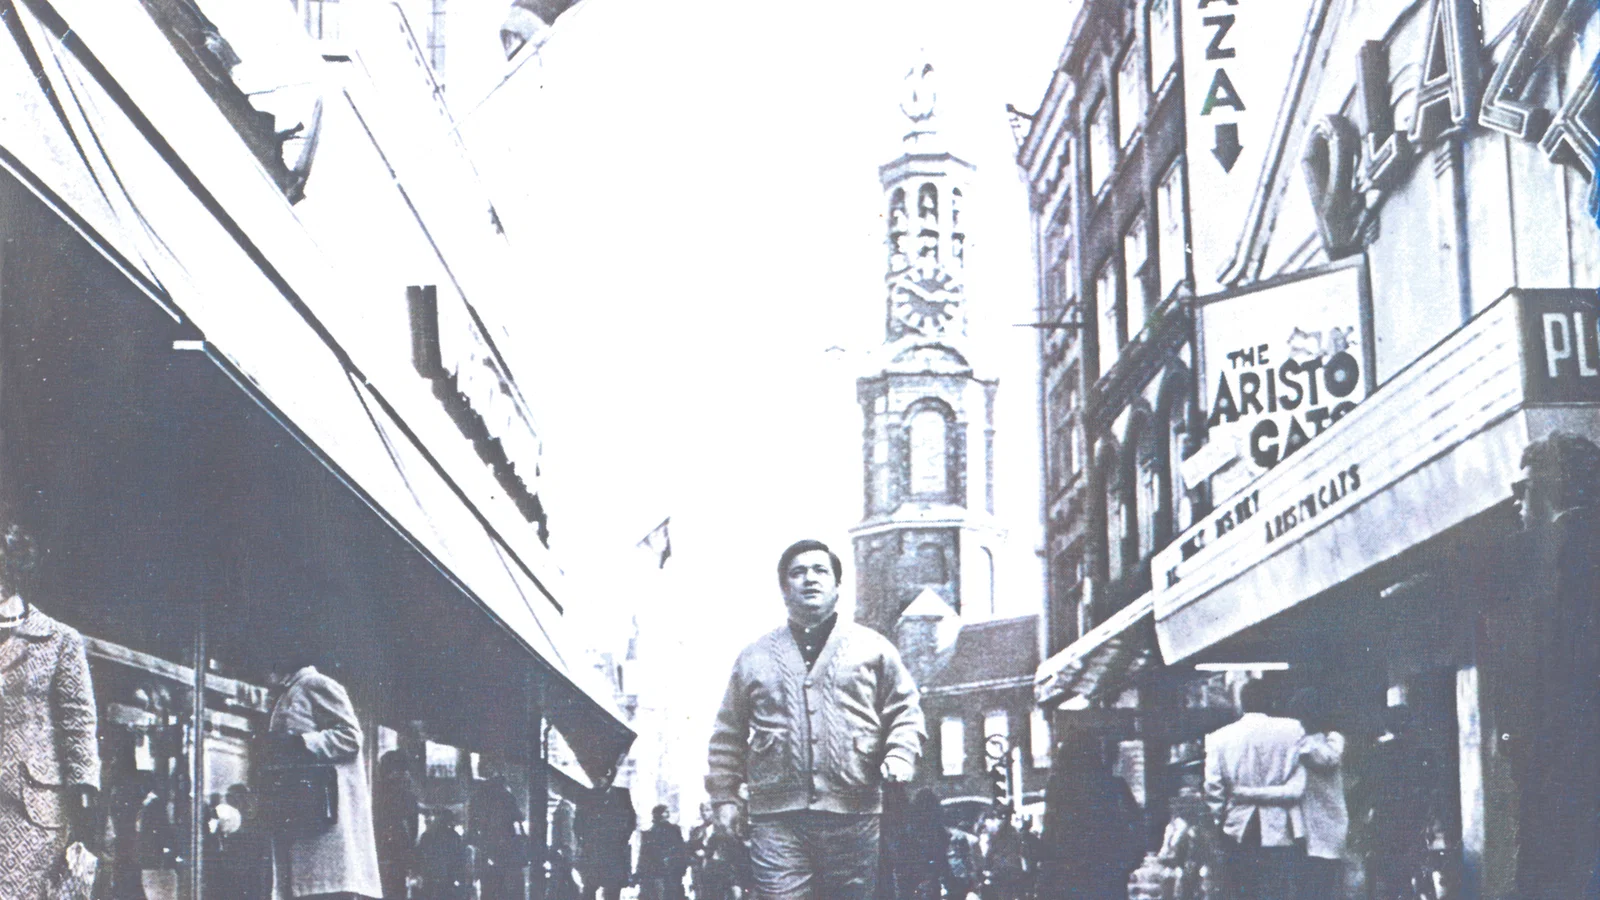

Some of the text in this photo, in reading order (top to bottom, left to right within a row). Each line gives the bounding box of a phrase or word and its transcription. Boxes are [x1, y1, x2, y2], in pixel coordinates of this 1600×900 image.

[1198, 0, 1246, 116] ZA
[1226, 343, 1270, 370] THE
[1542, 311, 1600, 378] PL
[1207, 351, 1360, 427] ARISTO
